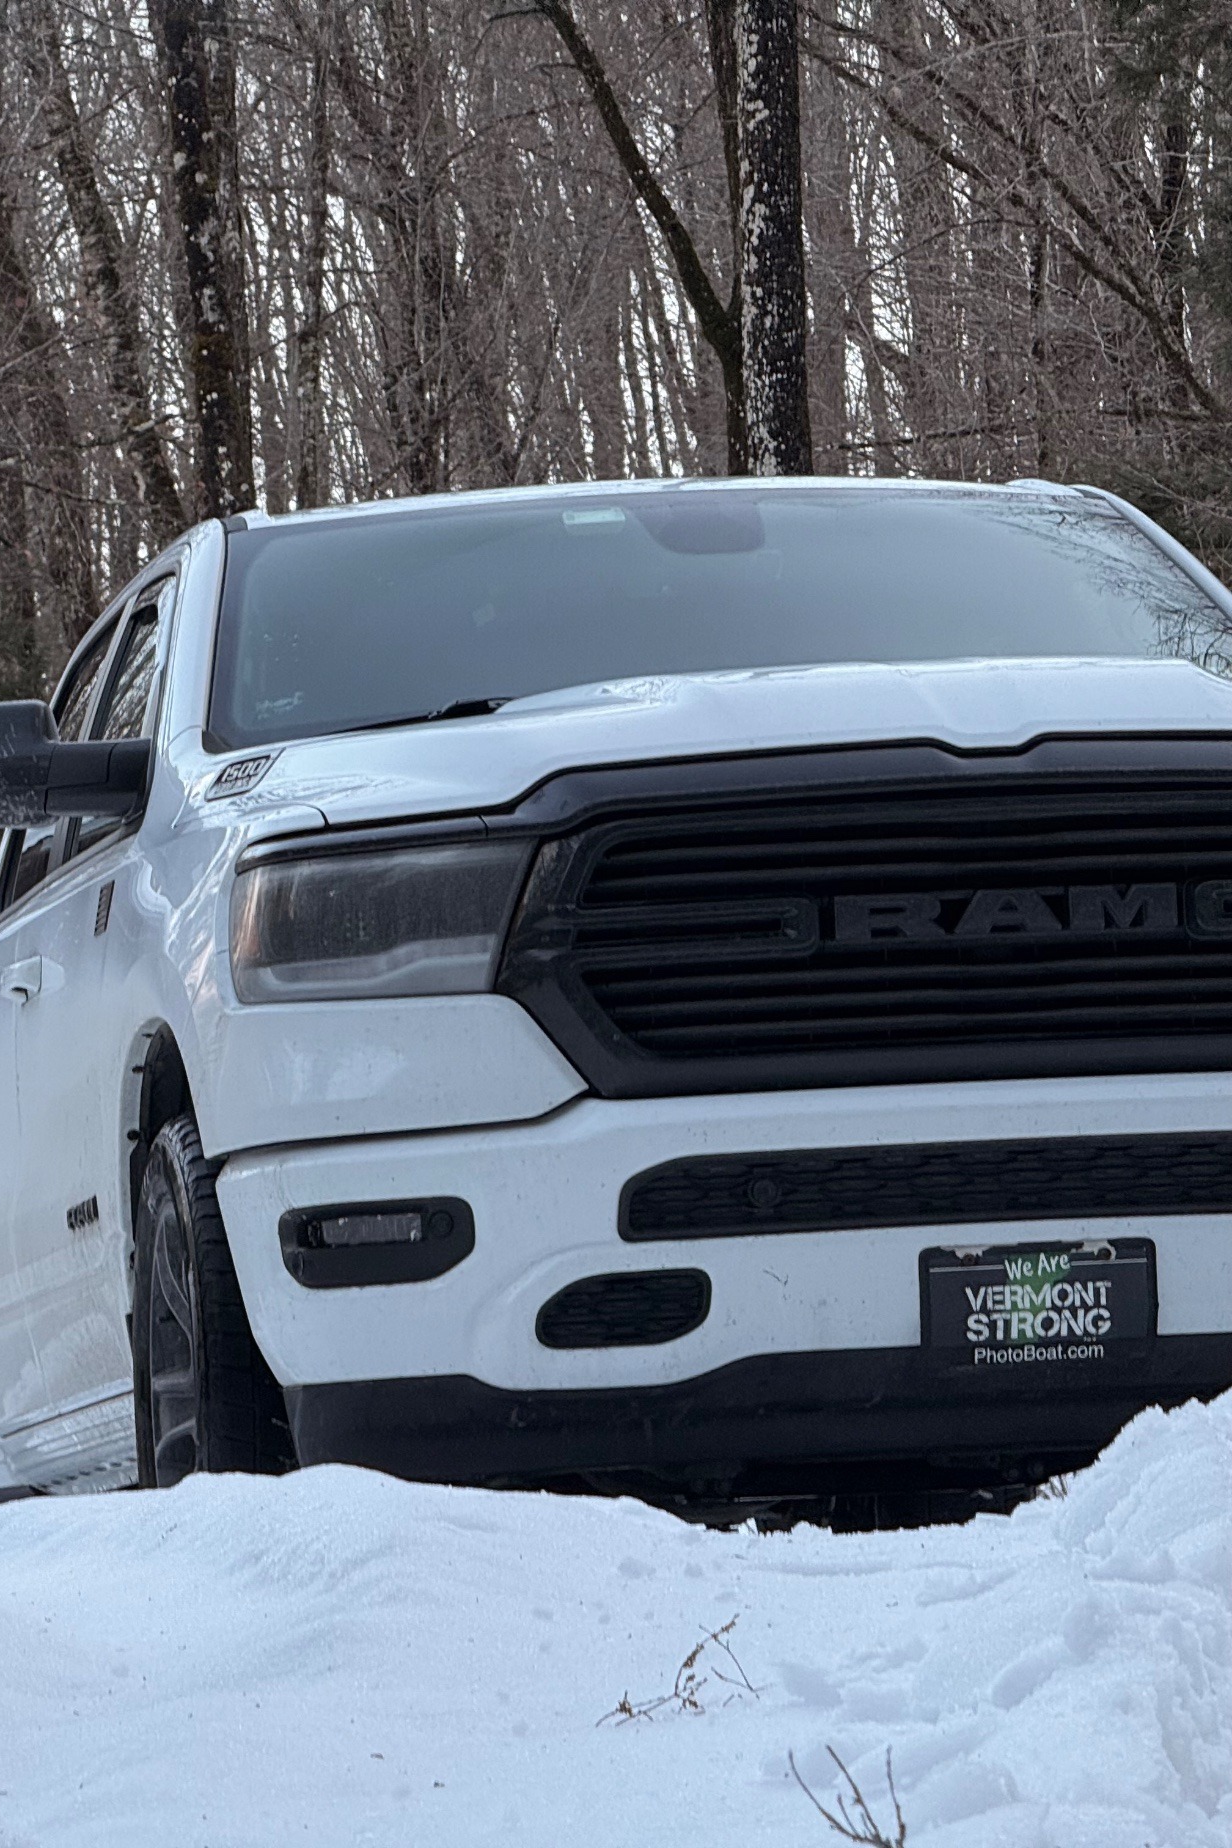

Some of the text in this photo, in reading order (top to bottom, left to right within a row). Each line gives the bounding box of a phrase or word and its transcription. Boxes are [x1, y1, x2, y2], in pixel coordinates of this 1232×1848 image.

[221, 758, 266, 783] 1500
[834, 881, 1179, 942] RAM
[1004, 1252, 1070, 1281] We Are
[965, 1279, 1111, 1312] VERMONT
[966, 1308, 1111, 1341] STRONG
[974, 1343, 1104, 1365] PhotoBoat.com
